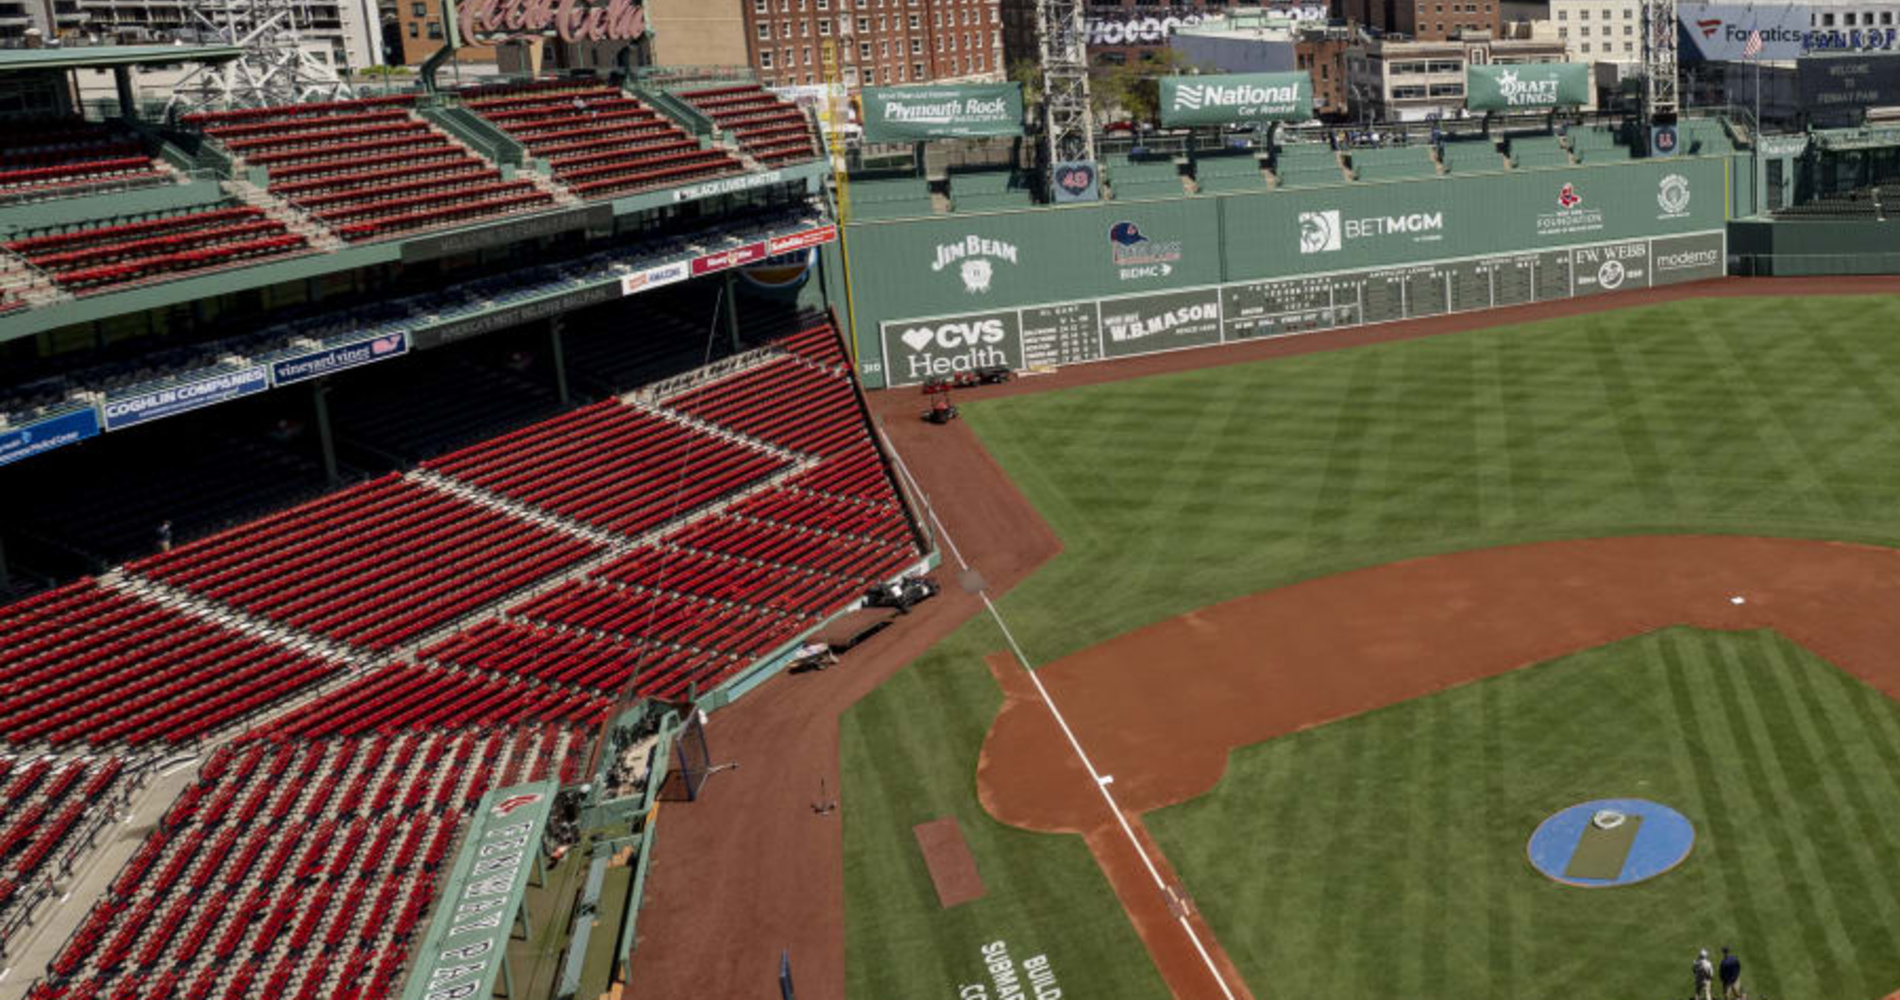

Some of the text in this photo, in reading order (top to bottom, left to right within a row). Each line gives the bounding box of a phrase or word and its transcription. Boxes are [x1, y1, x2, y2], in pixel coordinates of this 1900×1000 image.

[1725, 24, 1801, 42] Faatics
[1802, 29, 1864, 49] BANK
[1868, 28, 1897, 48] OF
[1204, 82, 1301, 106] National
[1500, 80, 1560, 97] DRAFT
[1507, 92, 1558, 106] KINGS
[883, 100, 962, 121] Plymouth
[966, 97, 1006, 115] Rock
[1238, 104, 1296, 117] Car Rental
[1345, 211, 1443, 239] BETMGM
[931, 234, 1017, 272] JIM BEAM
[1604, 243, 1646, 260] WEBB
[1657, 250, 1718, 268] moderna
[936, 319, 1005, 349] CVS
[278, 345, 371, 378] vineyard vines
[862, 362, 881, 374] 310
[907, 345, 1008, 379] Health
[106, 388, 176, 418] COGHLIN
[178, 367, 266, 400] COMPANIES
[450, 820, 533, 937] FENWAY
